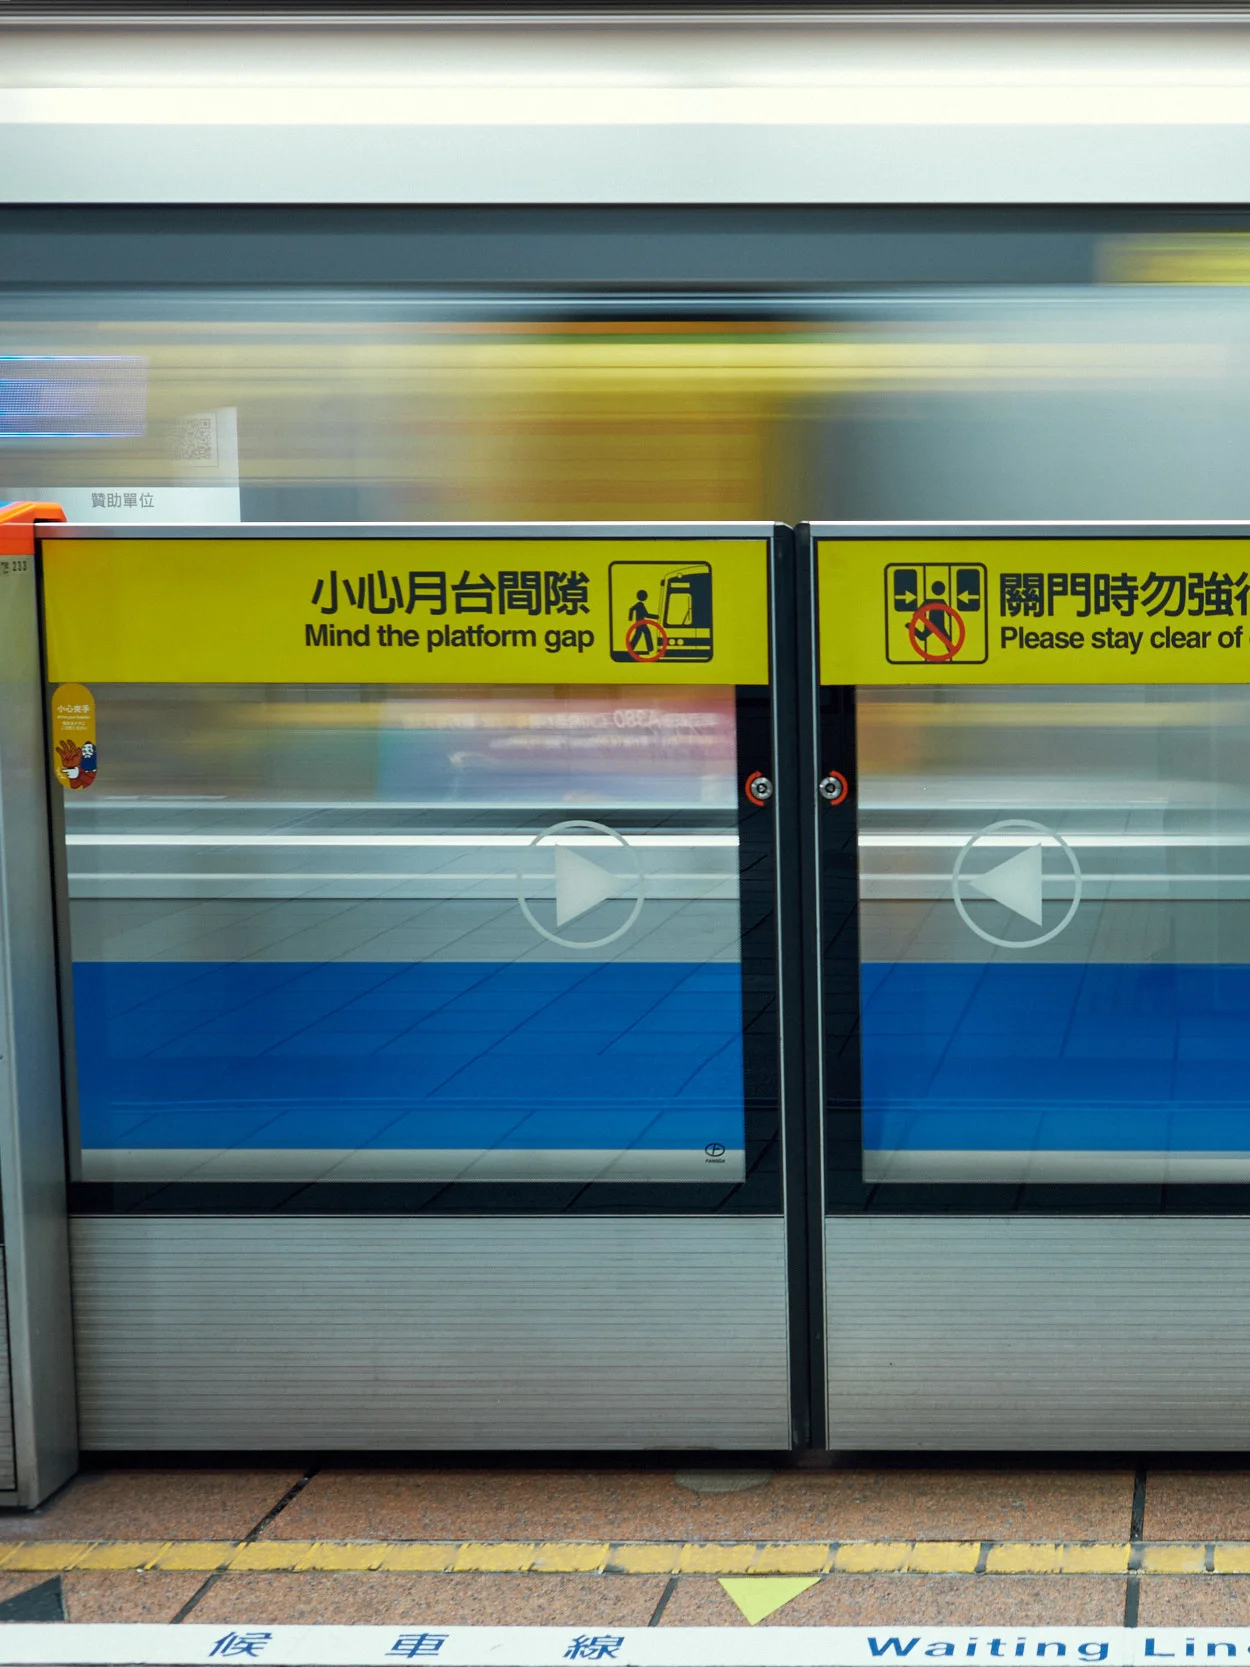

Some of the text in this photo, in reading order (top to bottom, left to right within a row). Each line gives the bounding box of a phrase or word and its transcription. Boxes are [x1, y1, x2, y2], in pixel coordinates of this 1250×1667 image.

[91, 492, 155, 508] 贊助單位
[311, 570, 591, 616] 小心月台間隙
[305, 624, 595, 653] Mind the platform gap
[1001, 626, 1084, 649] Please
[1092, 628, 1142, 655] stay
[1149, 625, 1211, 649] clear
[1217, 625, 1243, 649] of
[867, 1637, 1110, 1661] Waiting
